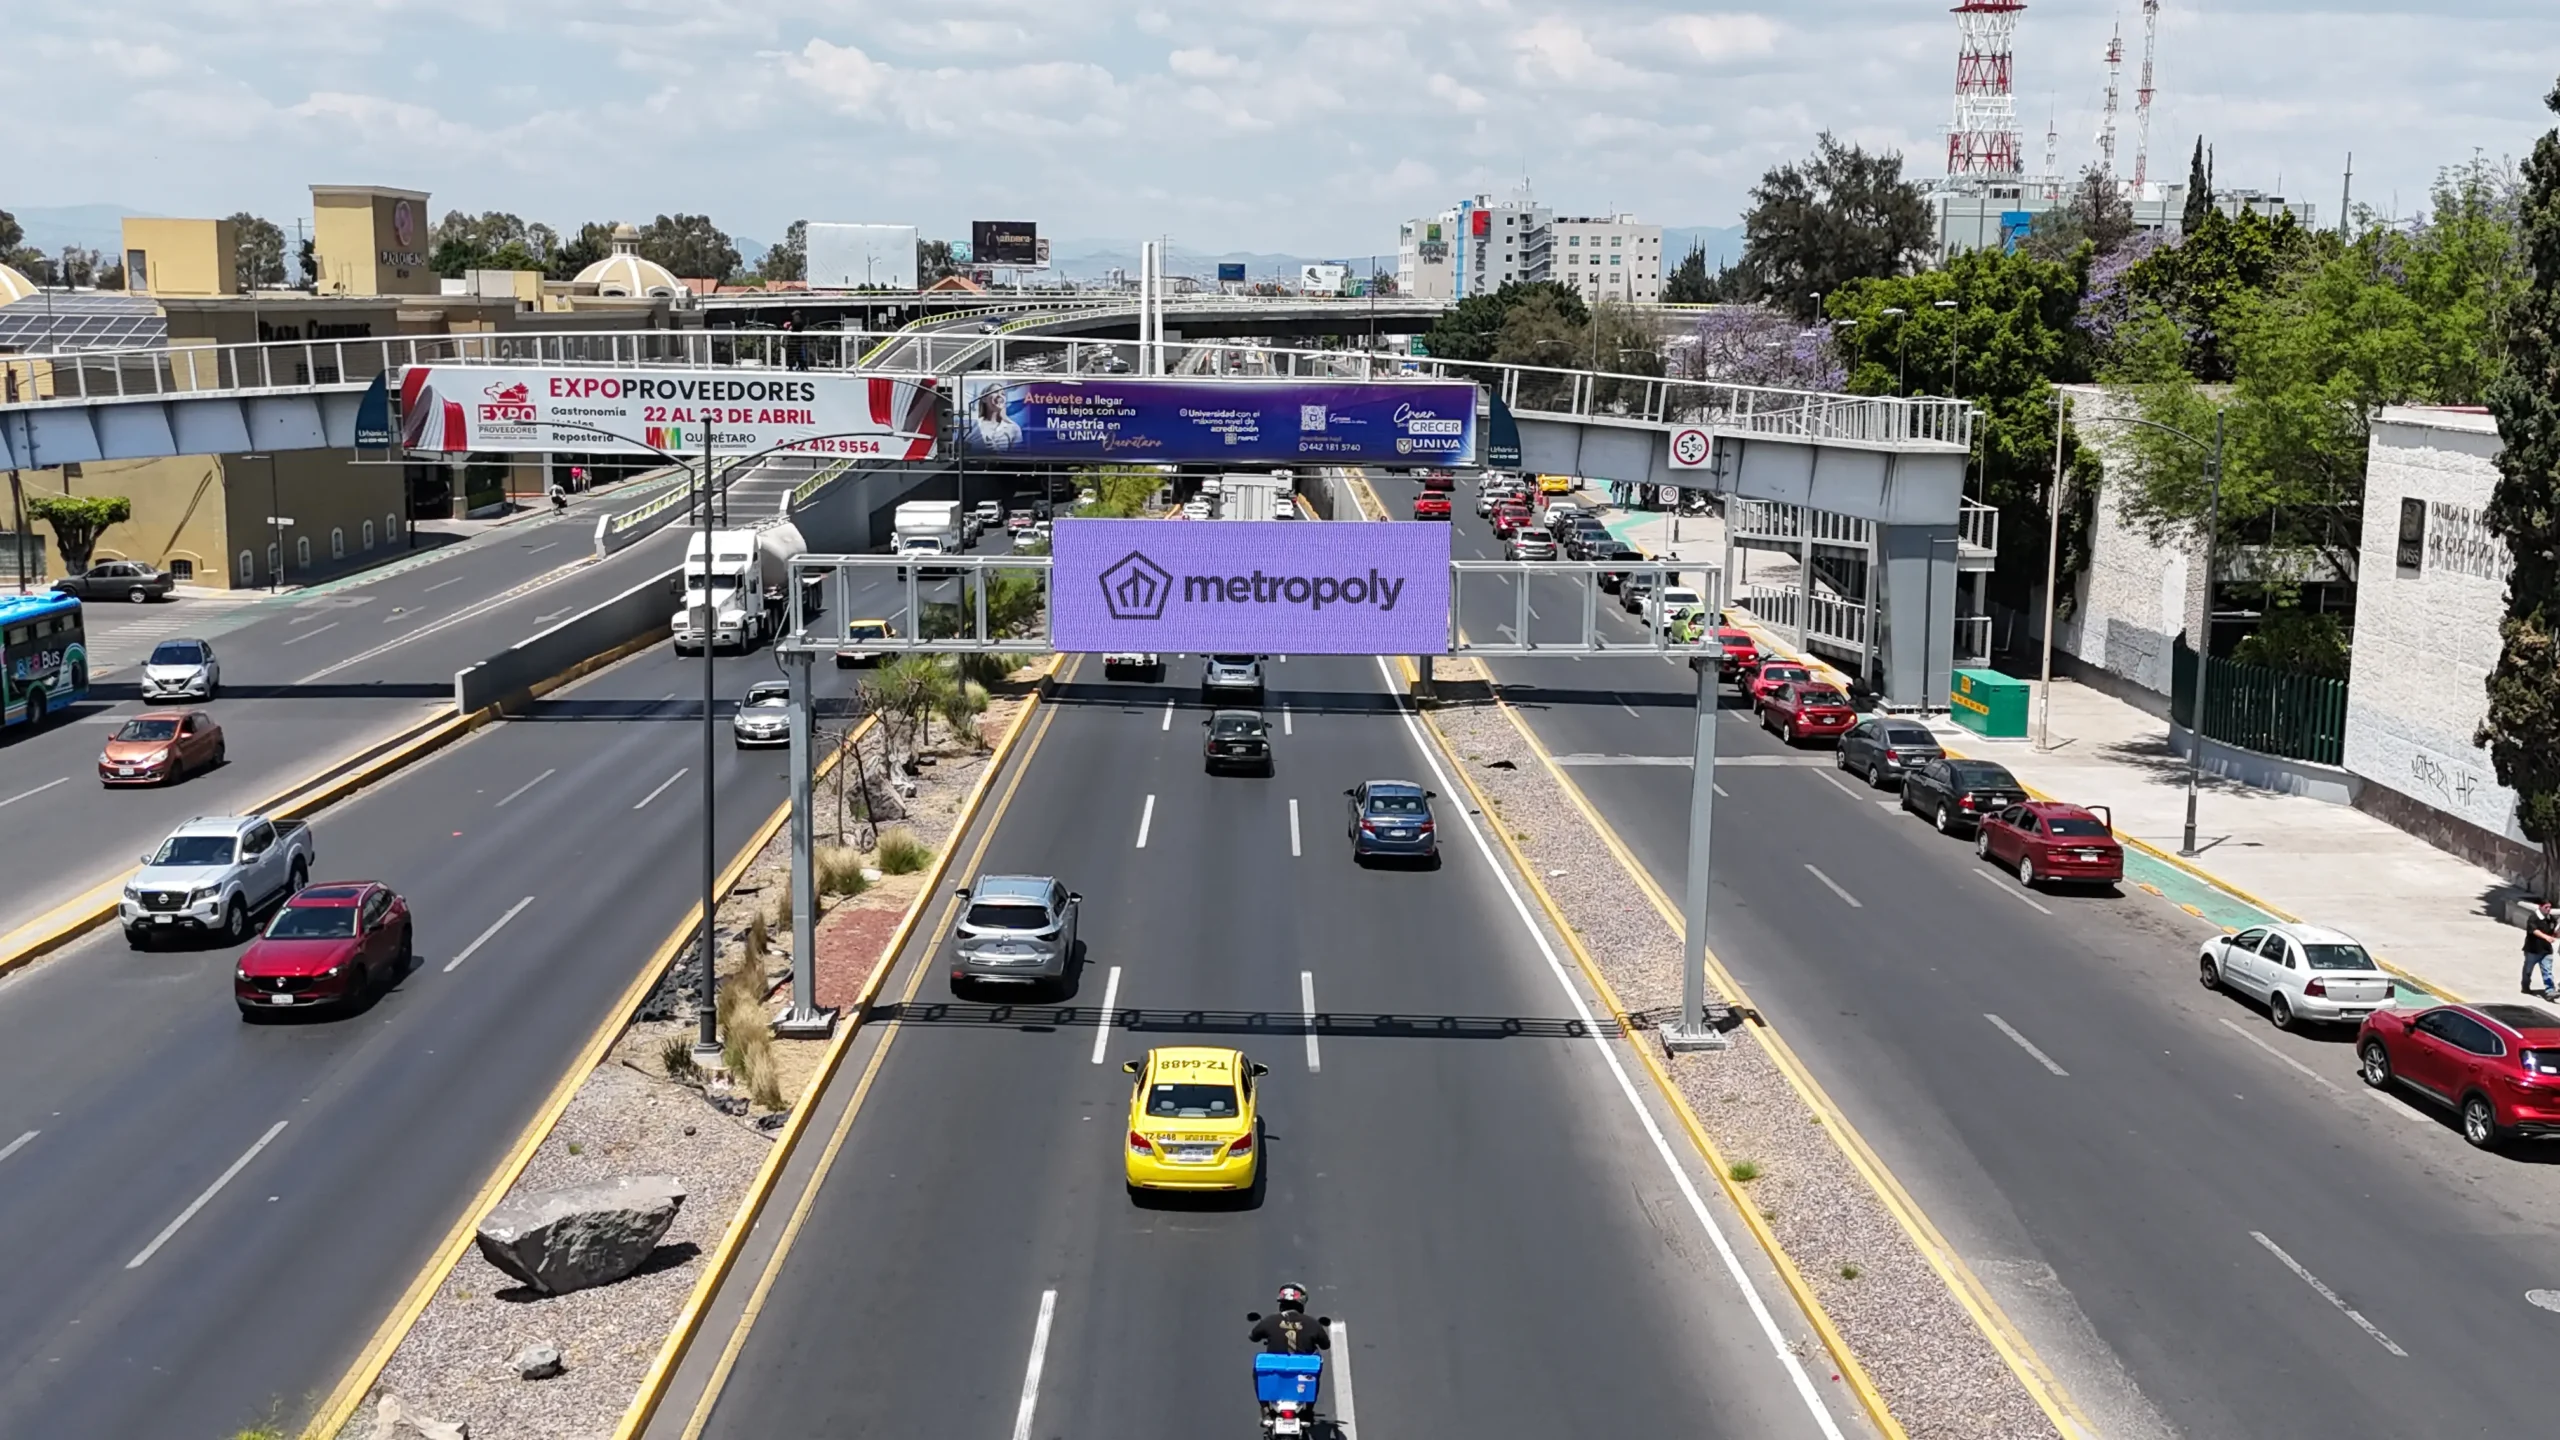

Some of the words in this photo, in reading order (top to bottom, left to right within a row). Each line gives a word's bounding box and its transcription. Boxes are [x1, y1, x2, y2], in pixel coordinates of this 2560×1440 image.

[550, 377, 815, 402] EXPOPROVEEDORES
[1023, 392, 1083, 404] Atrévete
[1094, 395, 1123, 407] llegar
[480, 406, 535, 421] EXPO
[551, 407, 627, 416] Gastronomía
[644, 406, 667, 422] 22
[671, 408, 696, 423] AL
[728, 409, 753, 424] DE
[758, 409, 816, 425] ABRIL
[1047, 405, 1068, 415] más
[1070, 405, 1093, 417] lejos
[1117, 408, 1136, 416] una
[1393, 403, 1436, 423] Crear
[1046, 417, 1105, 430] Maestría
[1411, 422, 1460, 432] CRECER
[478, 426, 538, 434] PROVEEDORES
[1057, 430, 1066, 440] la
[1069, 431, 1106, 440] UNIVA
[685, 432, 756, 444] QURÉTARO
[1412, 439, 1461, 449] UNIVA
[809, 438, 836, 452] 412
[839, 440, 880, 453] 9554
[1184, 568, 1404, 611] metropoly
[1161, 1060, 1228, 1070] TZ-6488
